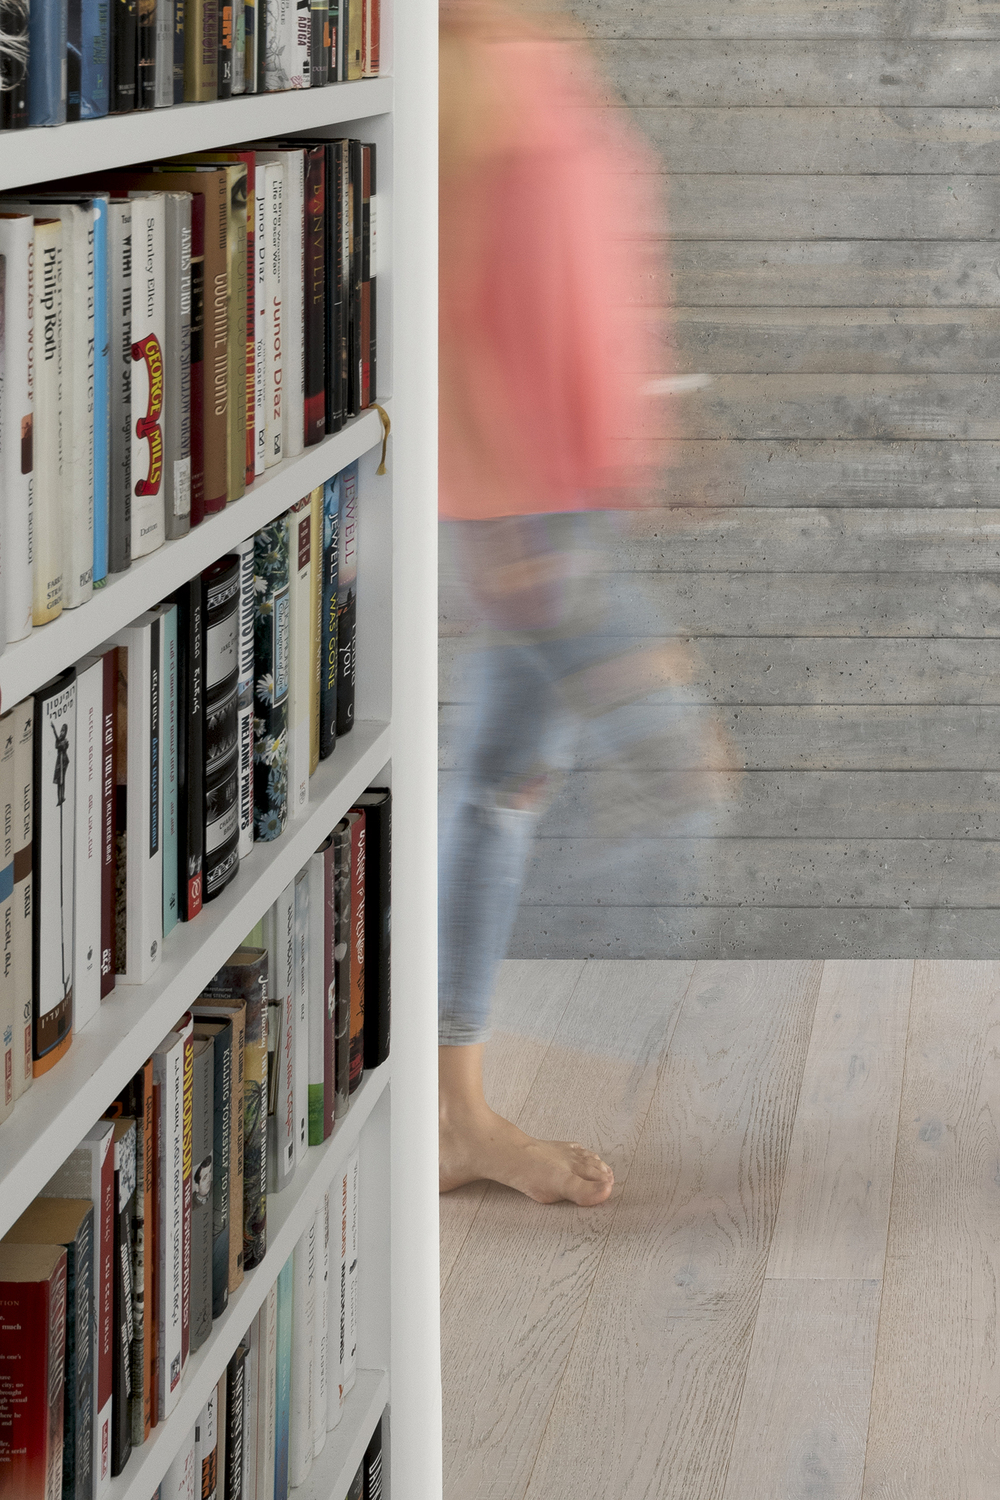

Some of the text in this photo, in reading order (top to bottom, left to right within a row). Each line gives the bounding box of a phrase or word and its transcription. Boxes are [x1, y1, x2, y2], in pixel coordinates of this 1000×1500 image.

[222, 6, 233, 49] CRY
[297, 16, 307, 47] ADIGA
[272, 202, 279, 214] of
[313, 184, 324, 304] BANVILLE
[39, 246, 57, 361] Philip Roth
[144, 218, 156, 318] Stanley Elkin
[181, 226, 191, 316] JAMES PURDY
[213, 274, 227, 416] COCAINE NIGHTS
[272, 296, 283, 420] Junot Díaz
[146, 340, 163, 484] GEORGE MILLS
[140, 523, 158, 537] Dutton
[329, 514, 339, 584] JEWELL
[343, 476, 355, 564] JEWELL
[241, 550, 254, 674] LONDONISTAN
[276, 602, 285, 692] The Progress of Love
[327, 592, 336, 690] WAS GONE
[339, 642, 352, 678] you
[22, 783, 31, 839] חיים באר
[241, 714, 250, 830] MELANIE PHILLIPS
[4, 802, 13, 858] עמוס עוז
[4, 906, 12, 978] מיכאל שלי
[257, 975, 270, 1050] Jack Handey
[182, 1043, 193, 1182] JON RONSON
[200, 1060, 211, 1150] FREDERICK EXLEY
[220, 1048, 229, 1222] KILLING YOURSELF TO LIVE
[259, 1054, 268, 1192] THE STENCH OF HONOLULU
[77, 1220, 90, 1376] VAL McDERMID
[120, 1242, 134, 1344] JONATHAN FRANZEN
[183, 1182, 192, 1327] THE PSYCHOPATH TEST
[200, 1211, 211, 1292] A FAN'S NOTES
